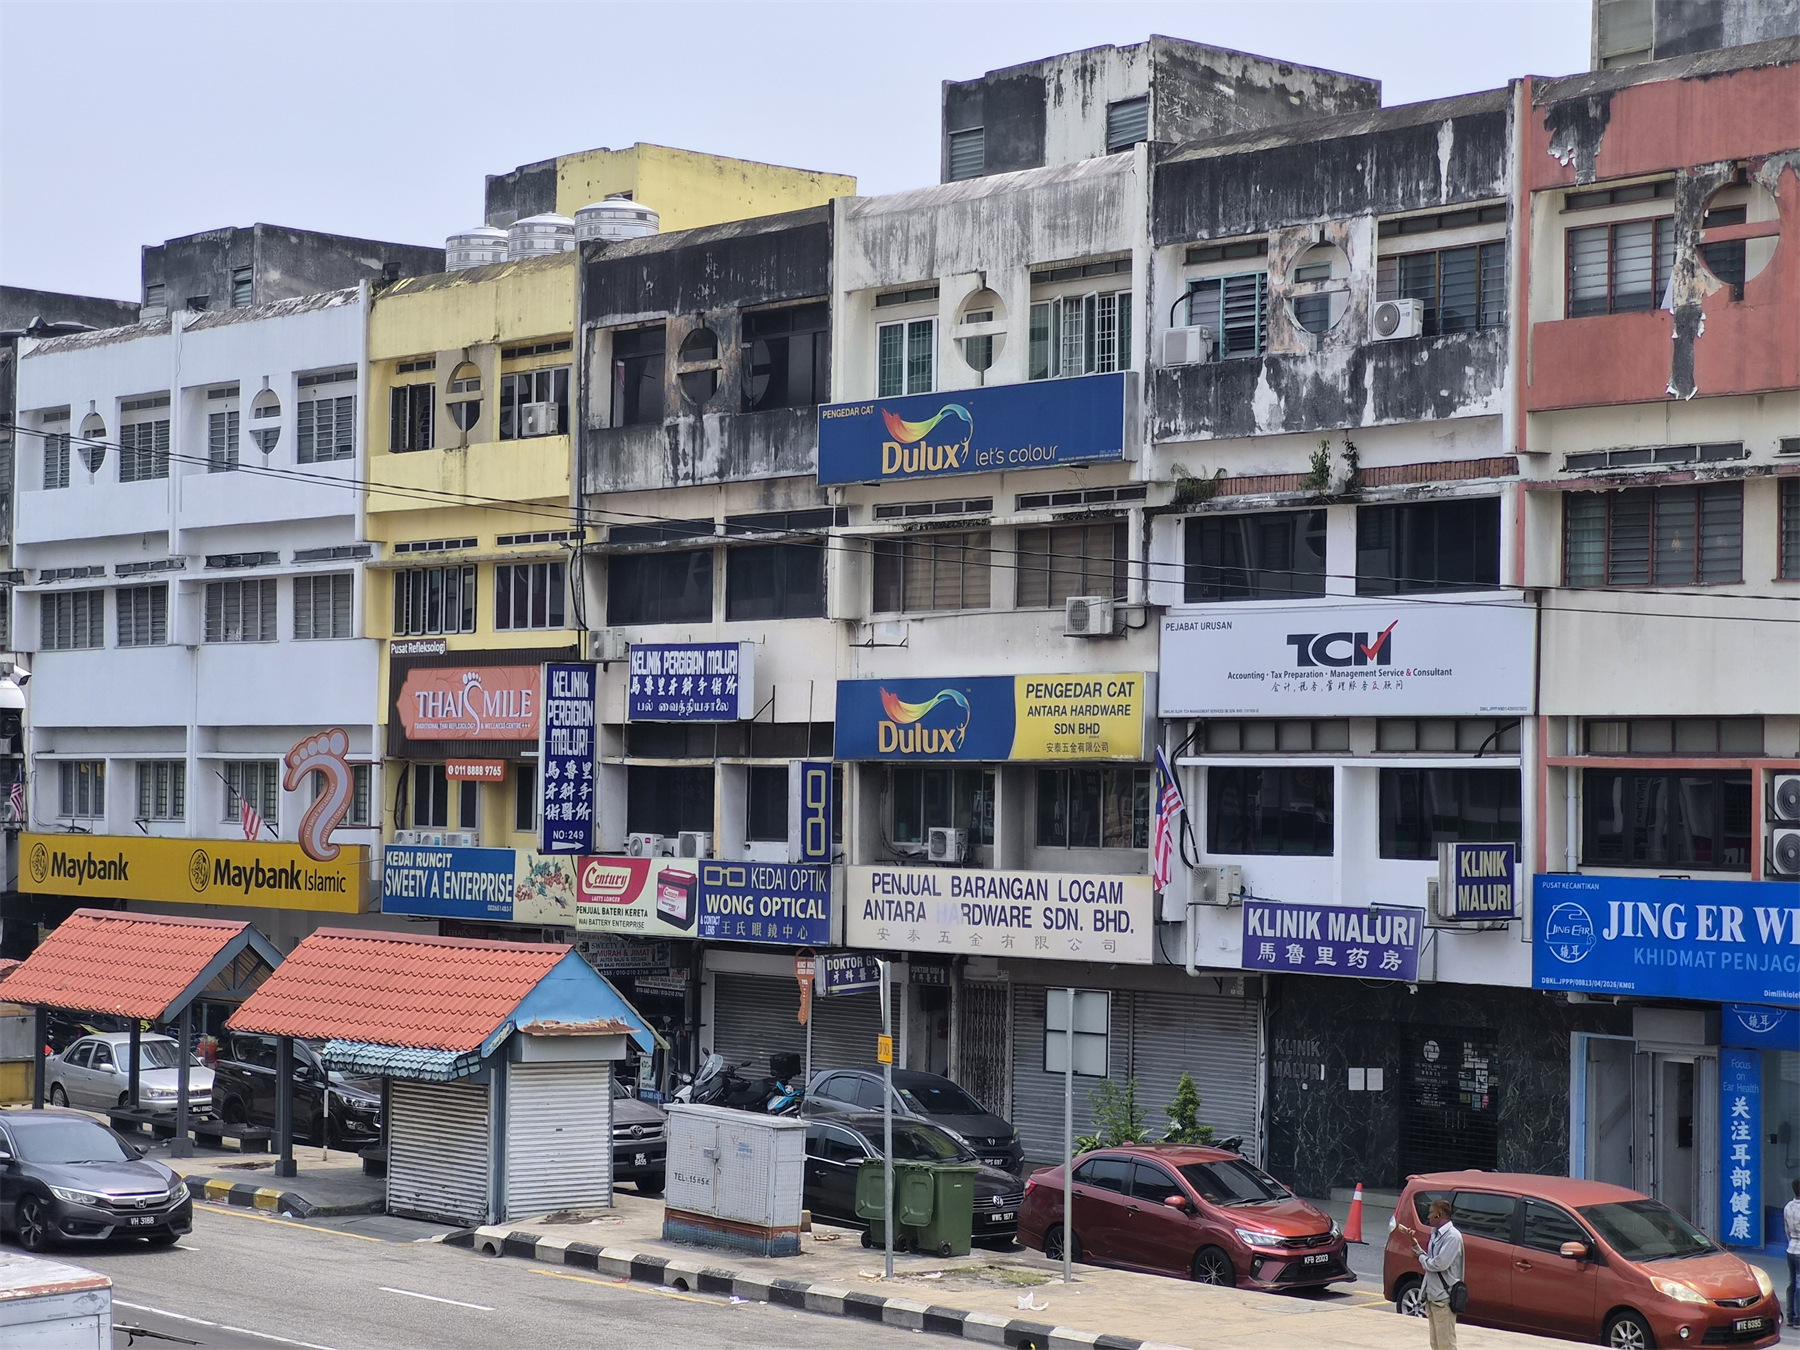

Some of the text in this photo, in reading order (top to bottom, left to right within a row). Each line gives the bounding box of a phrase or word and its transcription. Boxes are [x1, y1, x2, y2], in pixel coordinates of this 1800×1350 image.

[822, 405, 875, 419] PENGEDAR CAT
[881, 440, 960, 475] Dulux
[975, 448, 1005, 467] let's
[1008, 444, 1058, 463] colour
[1165, 621, 1232, 632] PEJABAT URUSAN
[390, 640, 446, 655] Pusat Refleksologi
[1286, 631, 1392, 667] TCH
[632, 650, 738, 675] KELINIK PERGIGIAN MALURI
[552, 670, 589, 698] KELINIK
[1227, 668, 1452, 681] Accounting Tax Preparation Management Service & Consultant
[1026, 681, 1135, 699] PENGEDAR CAT
[547, 700, 594, 726] PERGIGIAN
[1026, 704, 1130, 717] ANTARA HARDWARE
[878, 720, 956, 754] Dulux
[1054, 722, 1100, 735] SDN BHD
[551, 728, 588, 756] MALURI
[454, 765, 501, 776] 011 8888 9765
[51, 852, 130, 886] Maybank
[386, 851, 452, 868] KEDAI RUNCIT
[1460, 850, 1507, 878] KLINIK
[213, 858, 347, 896] Maybank Islamic
[384, 868, 514, 902] SWEETY A ENTERPRISE
[585, 866, 628, 889] Century
[751, 867, 826, 892] KEDAI OPTIK
[1561, 882, 1600, 890] KECANTIKAN
[872, 872, 1124, 905] PENJUAL BARANGAN LOGAM
[1458, 884, 1511, 912] MALURI
[576, 906, 600, 915] PENJUAL
[602, 907, 624, 916] BATERI
[624, 908, 648, 918] KERETA
[705, 894, 826, 920] WONG OPTICAL
[863, 898, 926, 922] ANTARA
[1042, 908, 1084, 932] SDN.
[1093, 909, 1134, 934] BHD.
[588, 918, 611, 927] BATTERY
[612, 920, 645, 929] ENTERPRISE
[704, 916, 720, 925] CONTACT
[705, 925, 716, 935] LENS
[721, 920, 808, 940] 王氏眼鏡中心
[1248, 908, 1416, 946] KLINIK MALURI
[1602, 900, 1688, 941] JING
[1695, 905, 1746, 943] ER
[876, 928, 1116, 954] 安泰五金有限公司
[826, 956, 863, 971] DOKTOR
[1634, 947, 1716, 969] KHIDMAT
[1274, 1038, 1321, 1058] KLINIK
[1272, 1060, 1326, 1081] MALURI
[1731, 1058, 1751, 1070] Focus
[1723, 1082, 1760, 1094] Ear Health
[1729, 1096, 1752, 1240] 关注耳部健康
[130, 1216, 154, 1225] VH 3188
